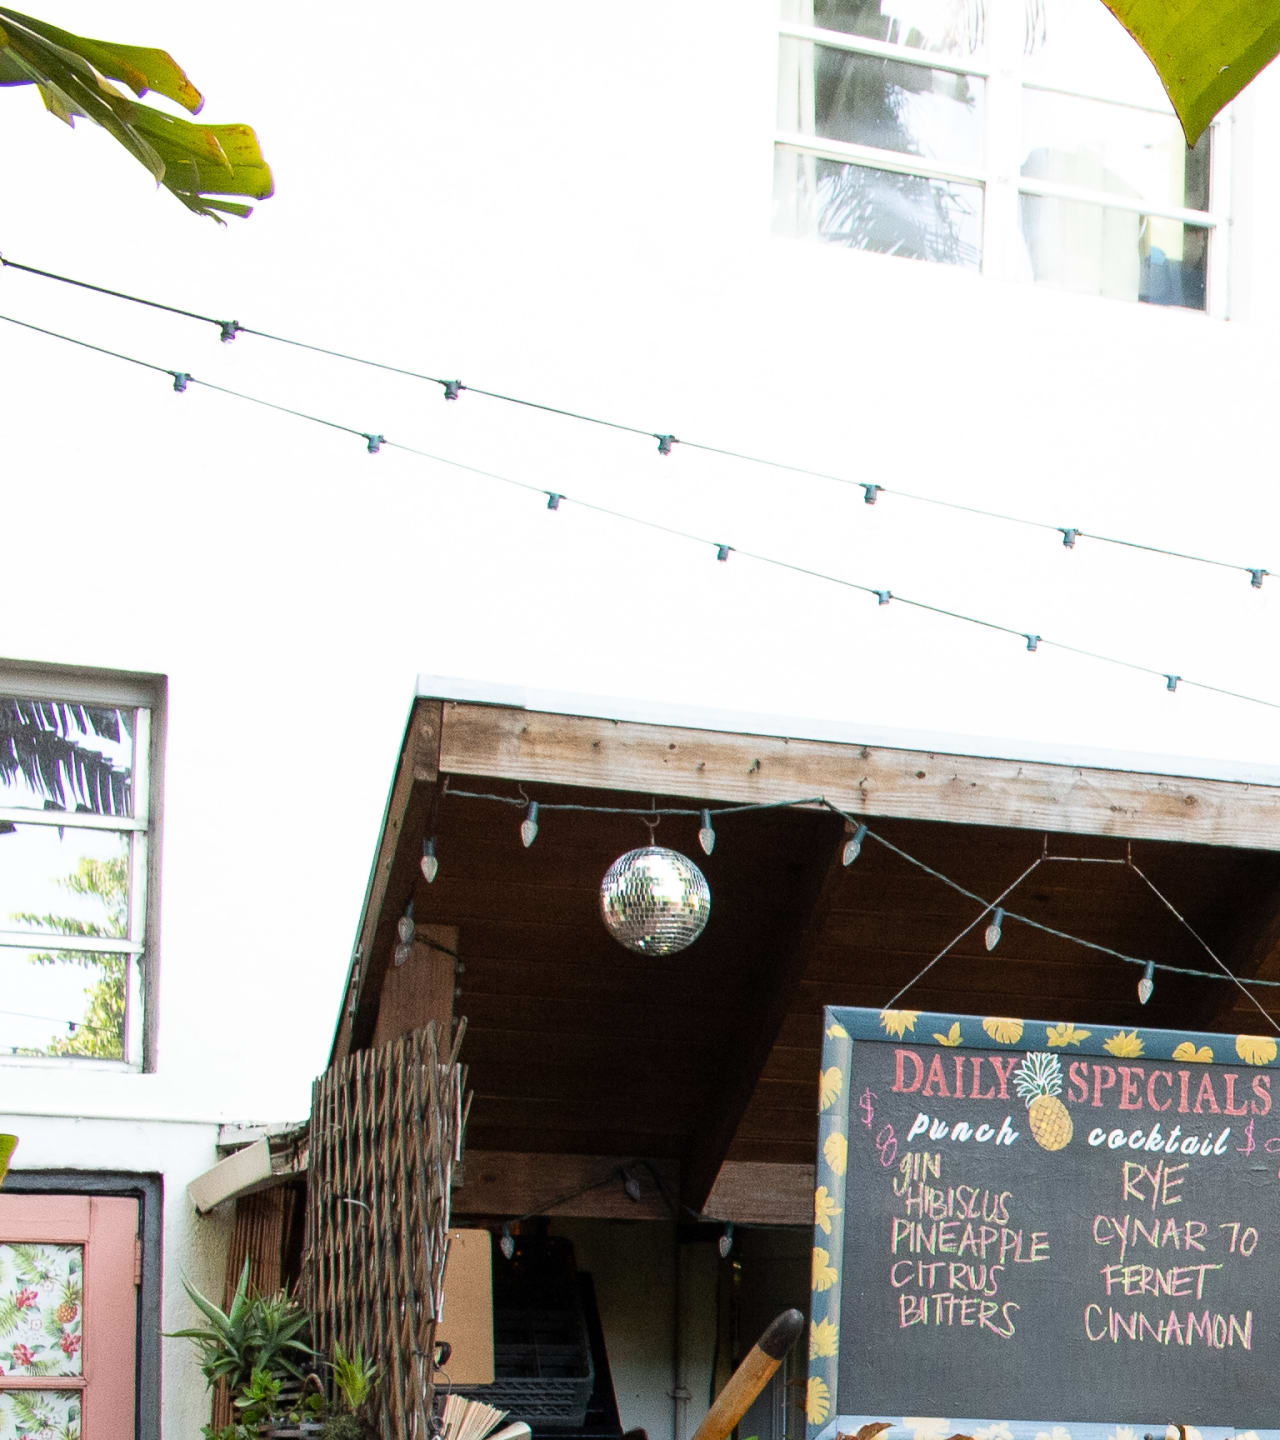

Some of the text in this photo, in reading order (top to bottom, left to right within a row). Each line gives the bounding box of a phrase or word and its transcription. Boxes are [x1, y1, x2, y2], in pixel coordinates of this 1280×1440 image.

[891, 1049, 1273, 1116] DAILY SPECIALS
[1088, 1123, 1231, 1156] cocktail
[905, 1182, 1013, 1226] HIBISCUS
[1122, 1159, 1189, 1211] RYE
[891, 1216, 1050, 1265] PINEAPPLE
[1092, 1214, 1259, 1263] CYNAR 70
[890, 1260, 1005, 1297] CITRUS
[1100, 1263, 1223, 1300] FERNET
[899, 1292, 1021, 1339] BITTERS
[1084, 1303, 1252, 1350] CINNAMON
